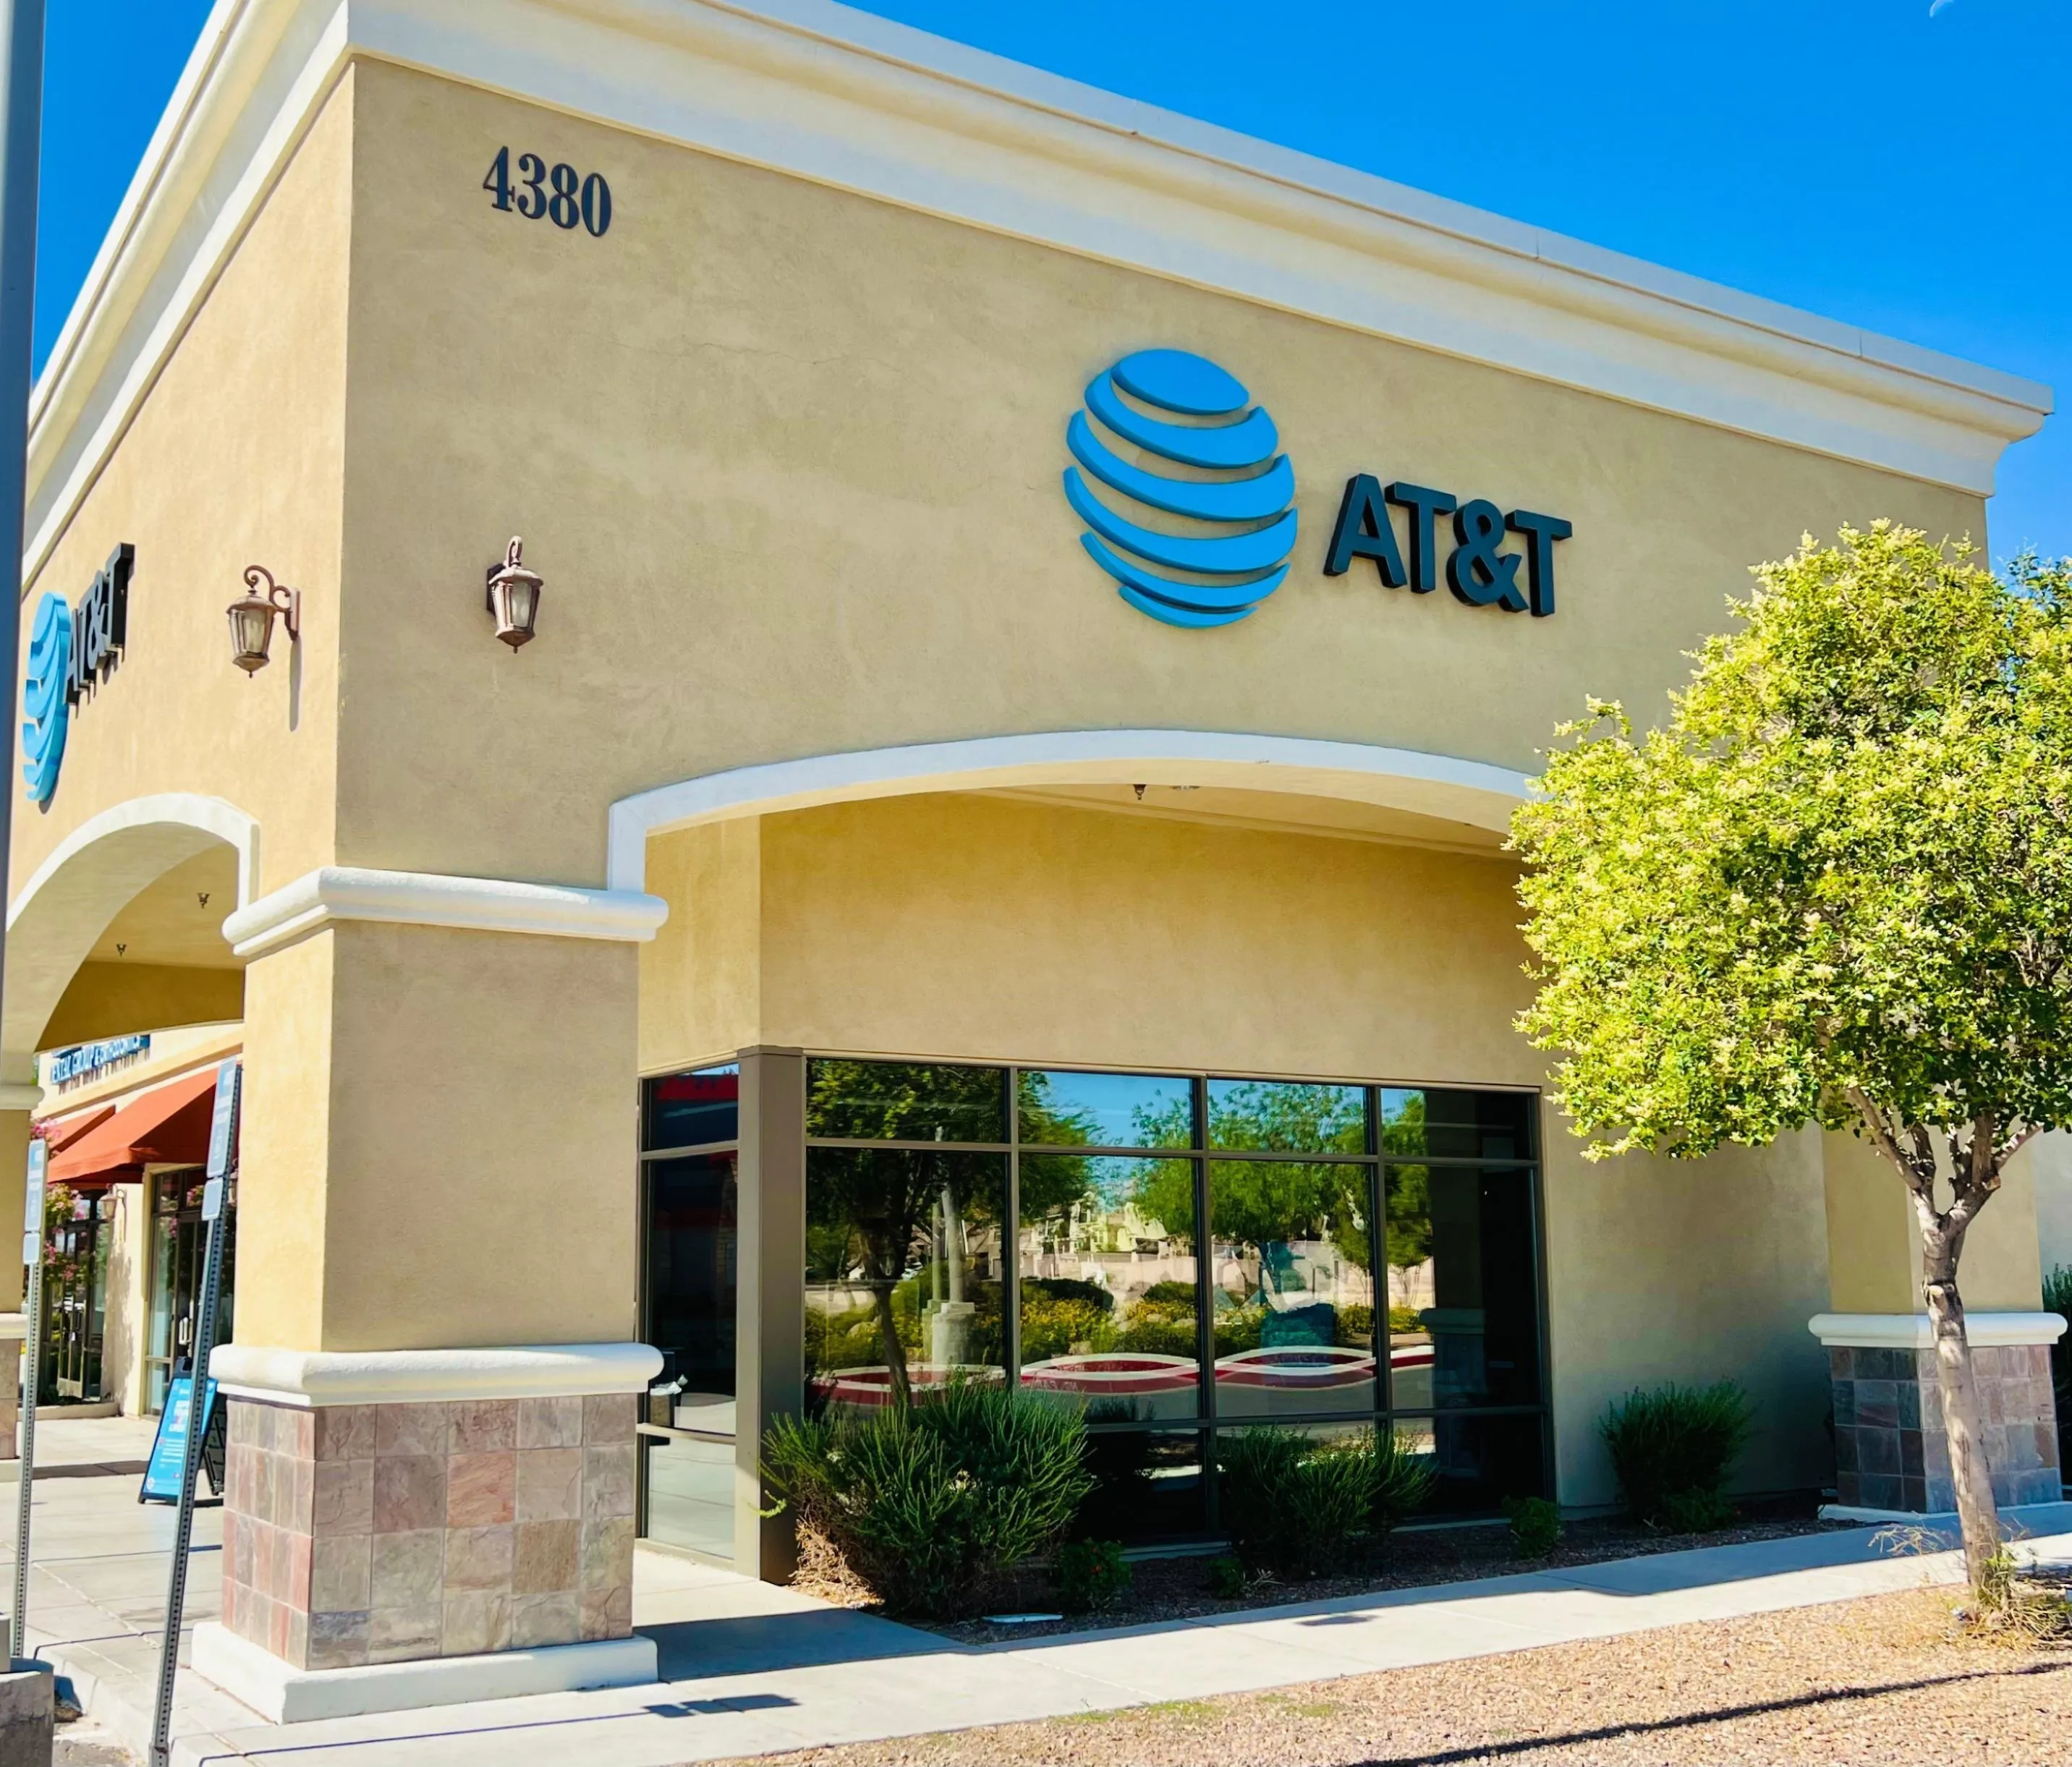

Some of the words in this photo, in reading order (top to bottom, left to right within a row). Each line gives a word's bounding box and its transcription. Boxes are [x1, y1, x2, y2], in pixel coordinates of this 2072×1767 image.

[483, 145, 612, 237] 4380
[1323, 473, 1573, 617] AT&T
[62, 542, 135, 706] AT&T
